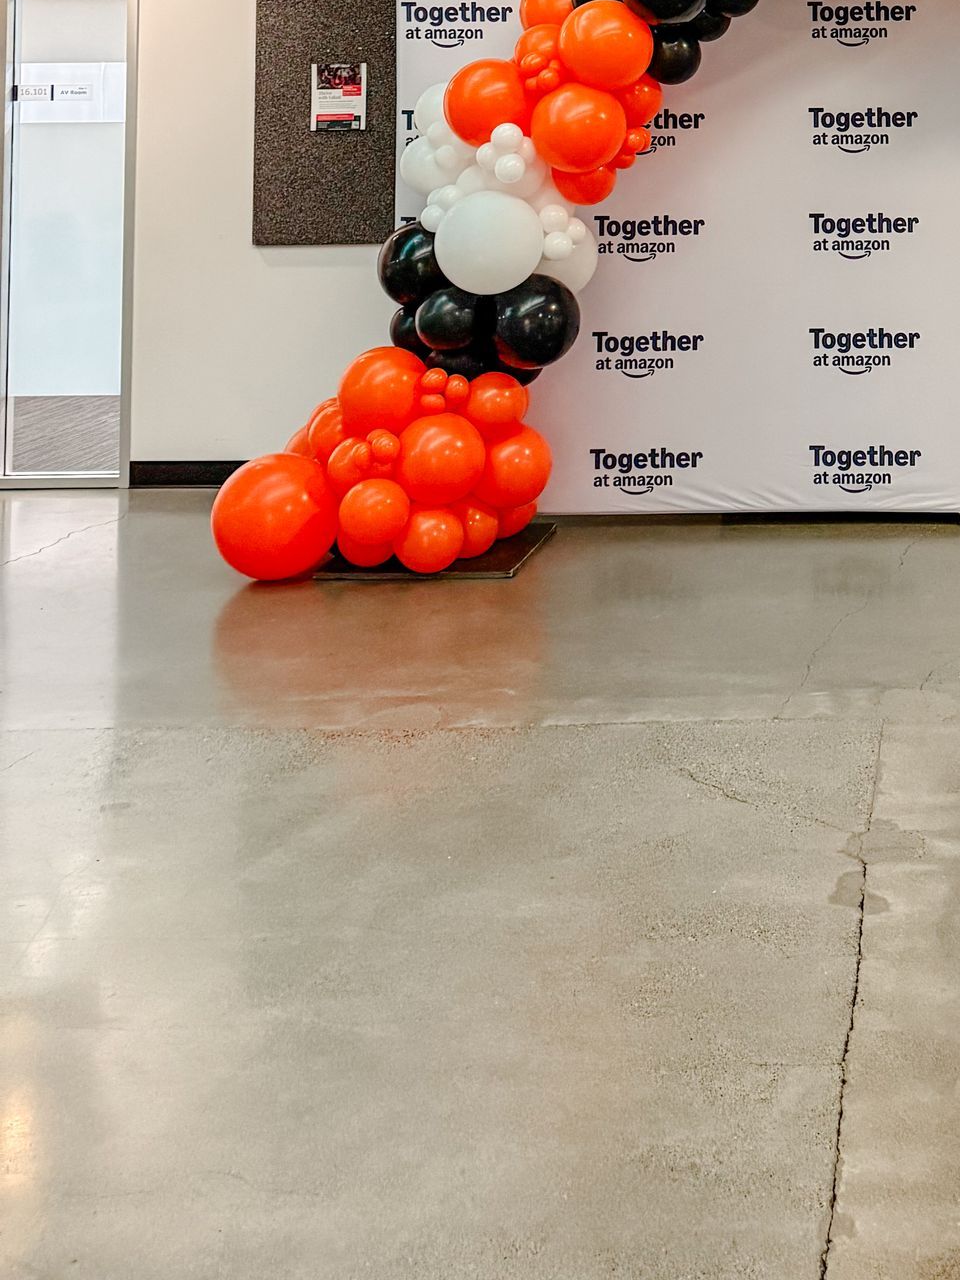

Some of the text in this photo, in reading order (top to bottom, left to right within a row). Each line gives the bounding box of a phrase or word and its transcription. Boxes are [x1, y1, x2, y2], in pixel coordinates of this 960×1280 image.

[401, 2, 513, 26] Together
[807, 1, 916, 26] Together
[406, 27, 483, 40] at amazon
[812, 26, 887, 39] at amazon
[20, 87, 48, 96] 16.101
[654, 108, 705, 129] ther
[808, 107, 918, 132] Together
[651, 135, 676, 147] zon
[813, 133, 889, 146] at amazon
[594, 215, 705, 240] Together
[809, 213, 919, 238] Together
[598, 241, 675, 255] at amazon
[813, 239, 889, 252] at amazon
[592, 331, 704, 356] Together
[809, 328, 920, 353] Together
[596, 357, 673, 371] at amazon
[813, 354, 890, 367] at amazon
[590, 448, 703, 474] Together
[809, 445, 921, 471] Together
[594, 474, 672, 488] at amazon
[814, 472, 891, 485] at amazon
